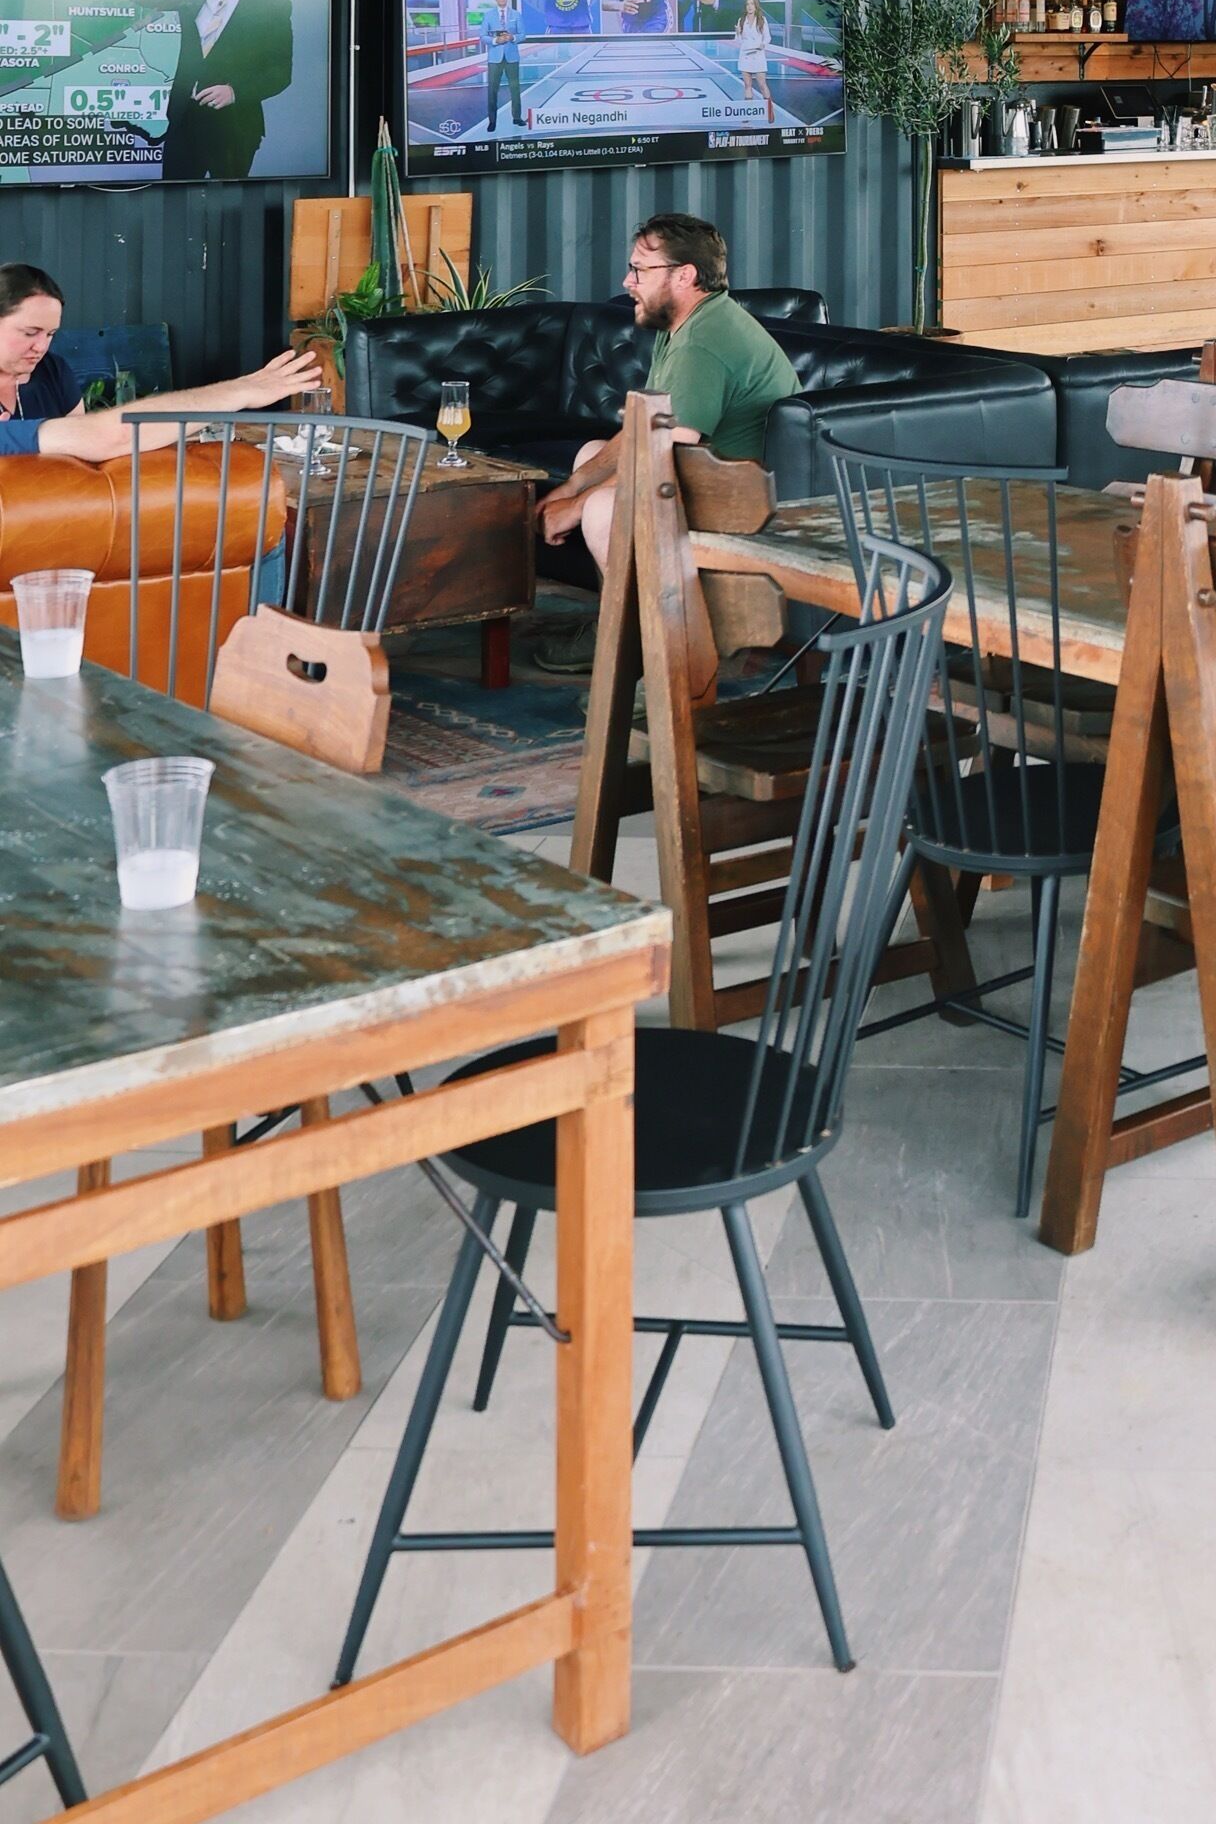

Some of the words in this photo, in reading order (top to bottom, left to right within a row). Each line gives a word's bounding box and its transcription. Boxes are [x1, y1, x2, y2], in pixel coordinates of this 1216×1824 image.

[68, 6, 136, 18] HUNTSVILLE
[34, 24, 65, 46] 2"
[0, 58, 40, 68] ASOTA
[100, 64, 147, 74] CONROE
[70, 89, 126, 111] 0.5"
[146, 111, 157, 120] 2"
[536, 112, 569, 125] Kevin
[571, 109, 628, 125] Negandhi
[702, 107, 722, 118] Elle
[724, 106, 765, 118] Duncan
[7, 117, 42, 130] LEAD
[45, 117, 64, 130] TO
[66, 117, 104, 130] SOME
[781, 128, 796, 137] HEAT
[43, 134, 60, 146] OF
[64, 134, 93, 147] LOW
[97, 133, 135, 146] LYING
[433, 145, 466, 157] ESPN
[500, 142, 524, 152] Angels
[537, 141, 554, 150] Rays
[32, 150, 103, 164] SATURDAY
[106, 149, 162, 162] EVENING
[500, 151, 528, 160] Detmers
[559, 149, 575, 158] ERA)
